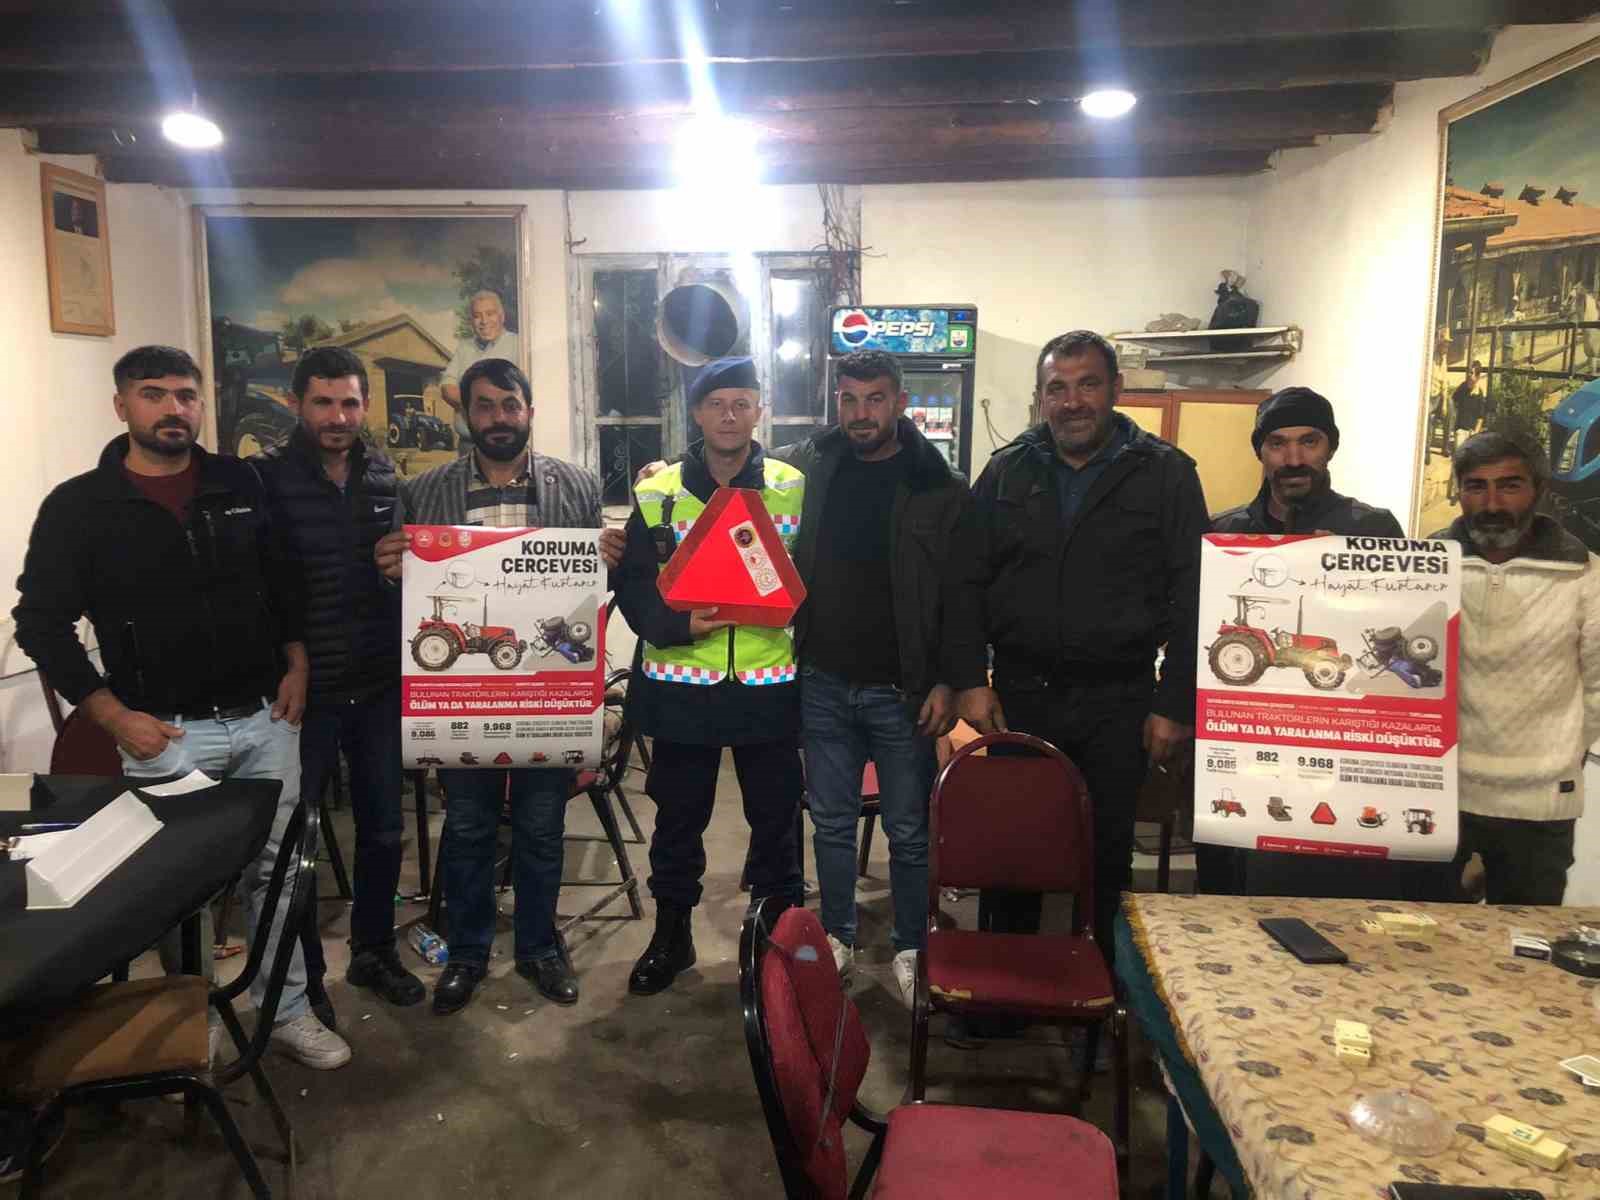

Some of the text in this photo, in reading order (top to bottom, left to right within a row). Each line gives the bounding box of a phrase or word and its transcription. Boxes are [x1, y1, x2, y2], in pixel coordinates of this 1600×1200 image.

[871, 321, 935, 337] PEPSI
[521, 540, 598, 556] KORUMA
[1346, 537, 1448, 553] KORUMA
[1310, 575, 1367, 597] Hayat
[409, 699, 437, 710] ÖLÜM
[438, 700, 450, 710] YA
[450, 700, 464, 710] DA
[464, 700, 518, 709] YARALANMA
[450, 721, 469, 730] 882
[1205, 718, 1238, 733] ÖLÜM
[1239, 723, 1254, 734] YA
[1255, 725, 1272, 736] DA
[1272, 726, 1341, 740] YARALANMA
[1343, 729, 1374, 743] RİSKİ
[1256, 751, 1279, 762] 882
[1297, 756, 1334, 769] 9.968
